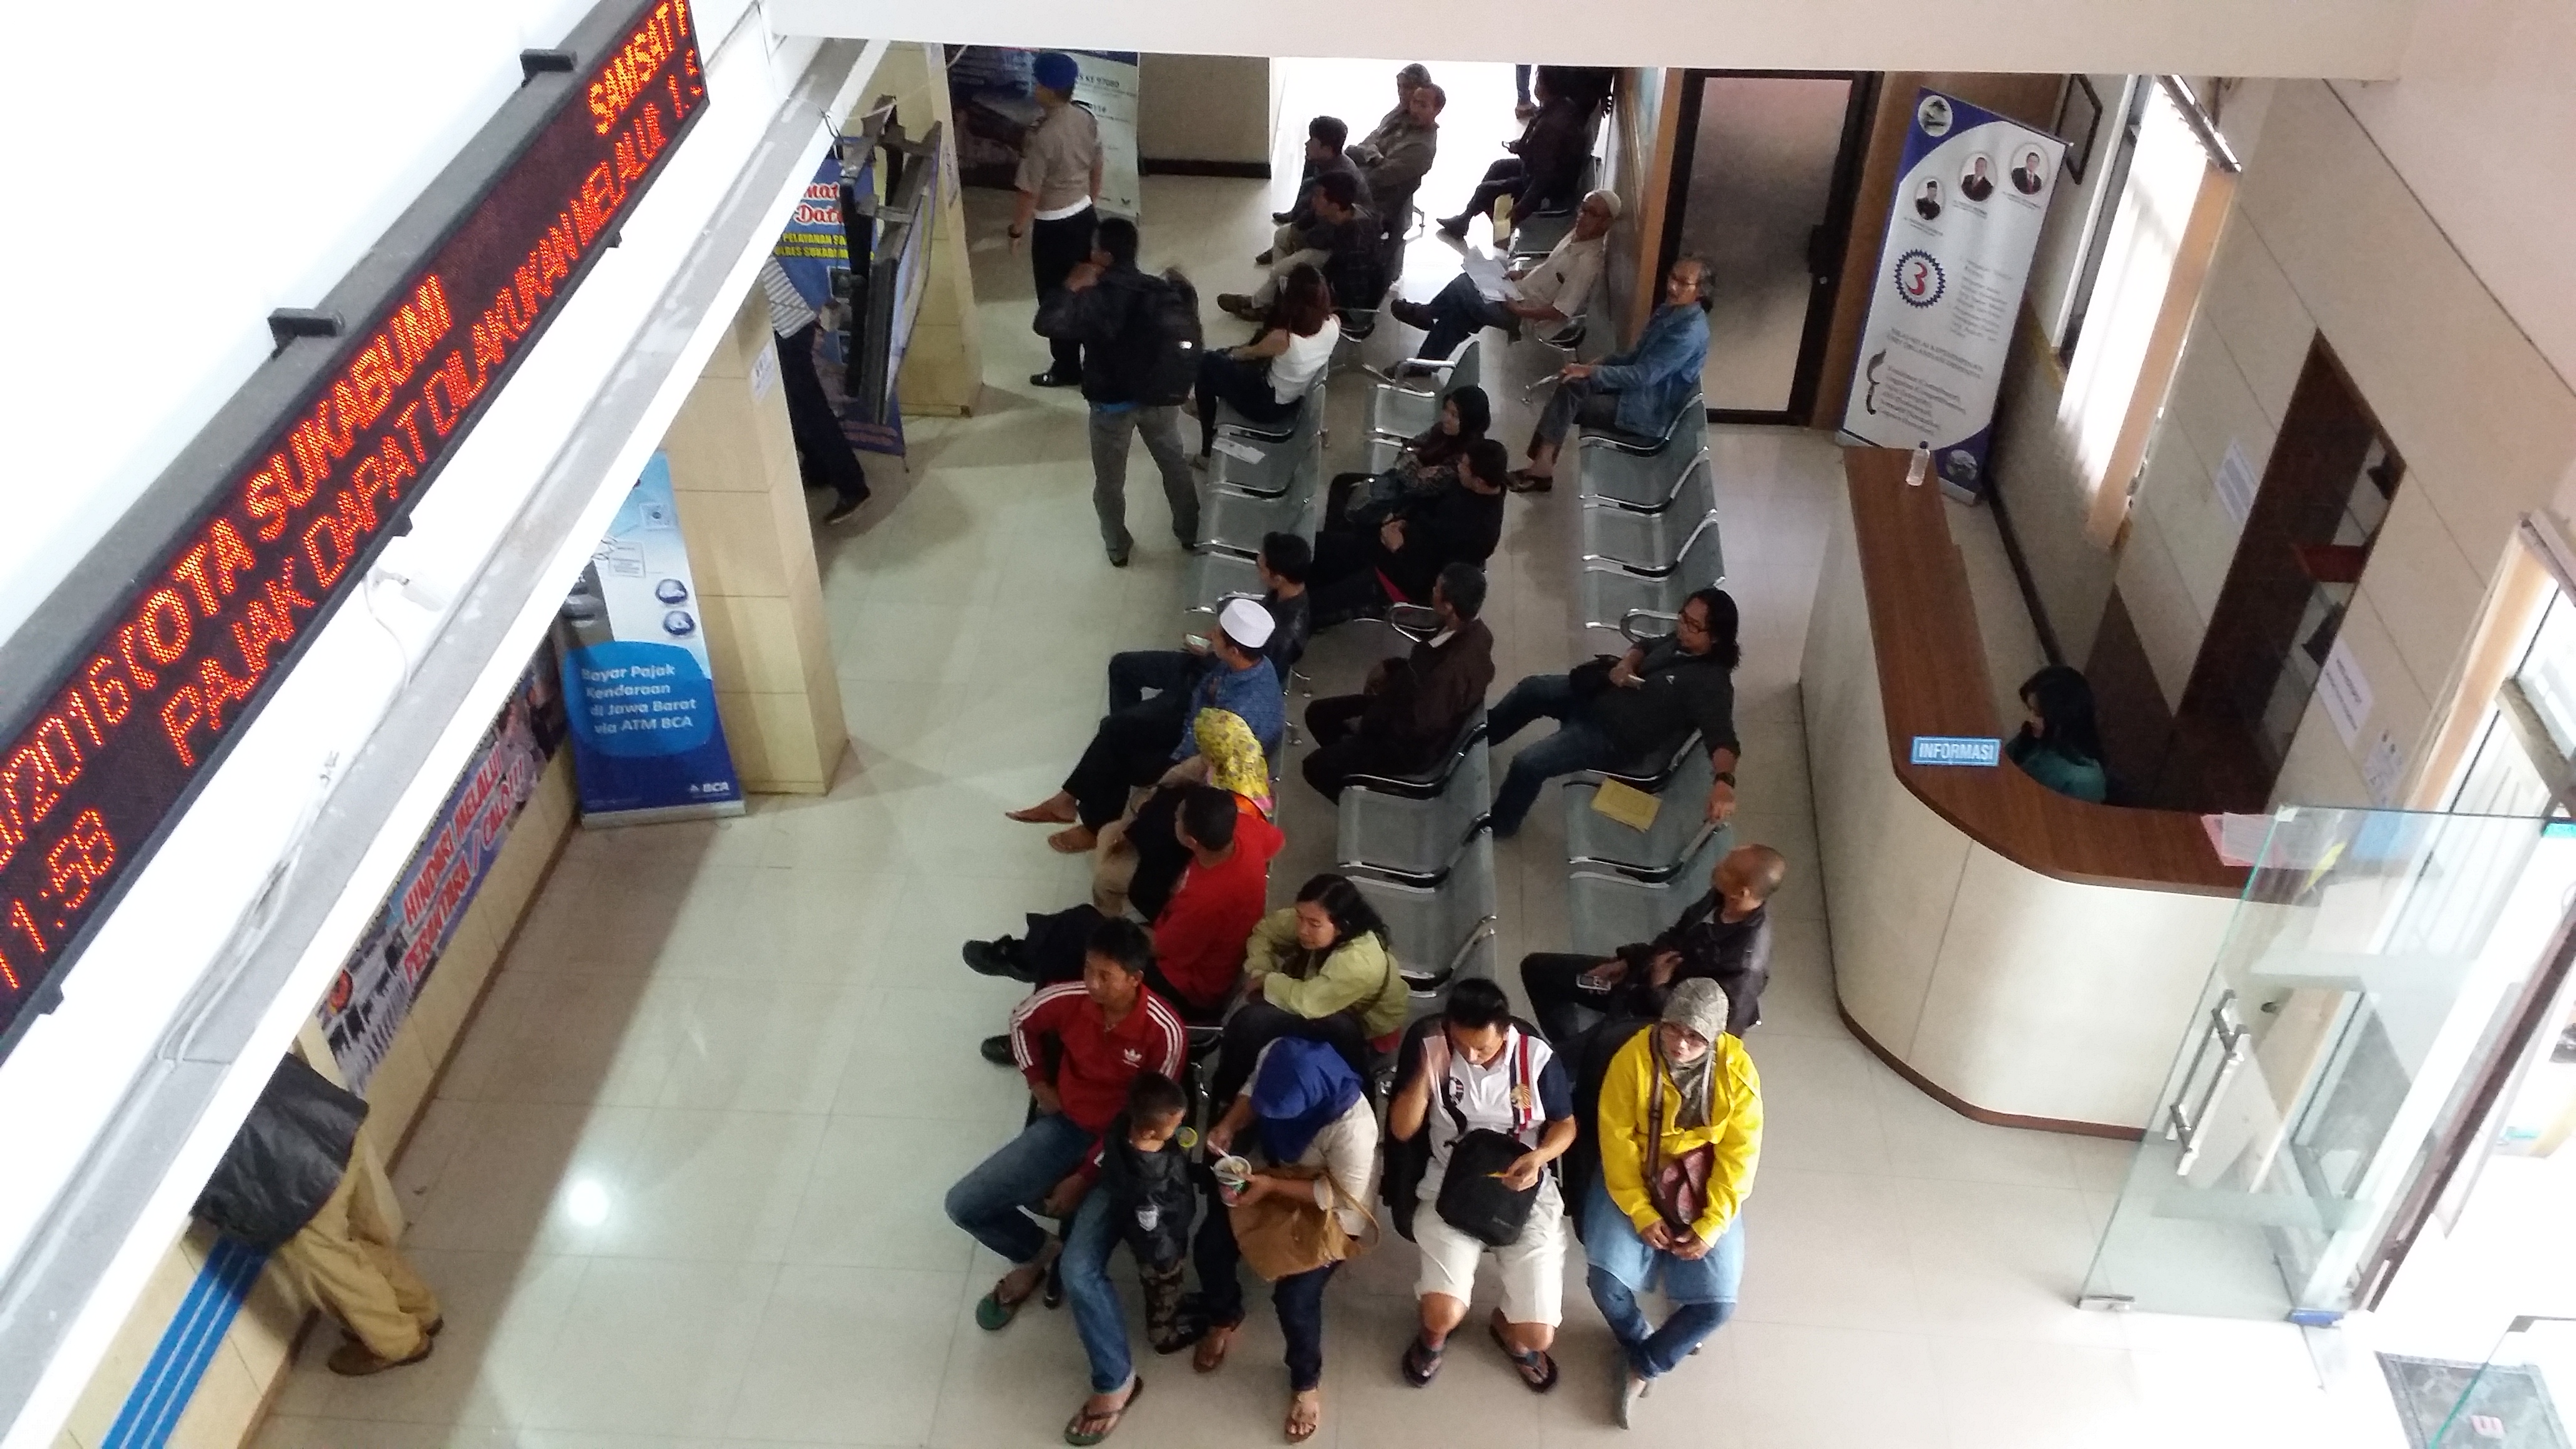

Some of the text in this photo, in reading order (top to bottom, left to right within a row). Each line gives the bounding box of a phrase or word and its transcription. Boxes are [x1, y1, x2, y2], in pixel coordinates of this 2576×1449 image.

[246, 273, 452, 542] SUKABUMI
[589, 1, 673, 135] SAMSAT
[1905, 261, 1928, 296] 3
[160, 556, 316, 768] PAJAK
[302, 400, 427, 588] DAPAT
[422, 212, 578, 436] DILAKUKAN
[570, 102, 666, 247] MELALUI
[581, 663, 676, 683] Bayar Pajak
[586, 684, 671, 699] Kendaraan
[591, 698, 697, 716] di Jawa Barat
[595, 715, 693, 734] via ATM BCA
[1918, 743, 1994, 760] INFORMASI
[703, 782, 729, 793] BCA
[404, 824, 456, 929] HINDARI
